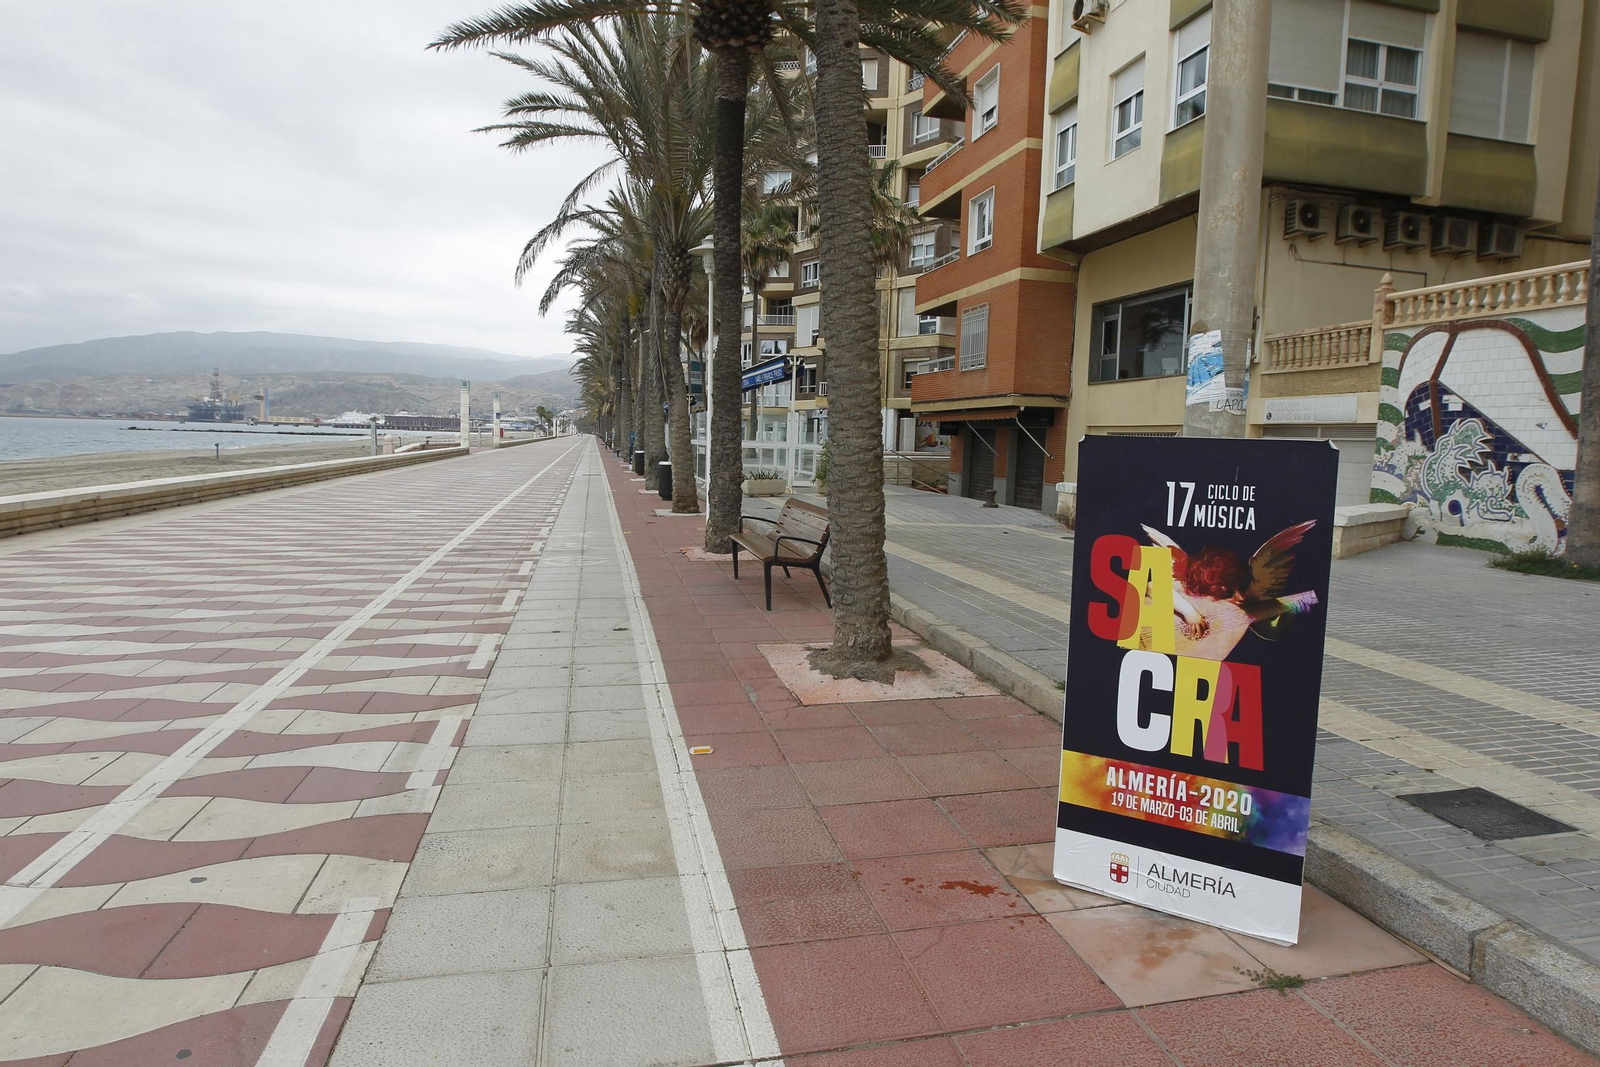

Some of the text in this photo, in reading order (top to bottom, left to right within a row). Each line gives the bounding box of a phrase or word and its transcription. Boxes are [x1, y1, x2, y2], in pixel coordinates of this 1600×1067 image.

[1166, 481, 1196, 527] 17
[1208, 484, 1256, 502] CICLO DE
[1194, 501, 1256, 530] MÚSICA
[1087, 534, 1176, 654] SA
[1117, 649, 1264, 772] CRA
[1111, 791, 1124, 806] 19
[1126, 794, 1139, 810] DE
[1195, 808, 1208, 825] DE
[1210, 813, 1240, 834] ABRIL
[1146, 878, 1191, 899] CIUDAD
[1147, 862, 1236, 899] ALMERÍA
